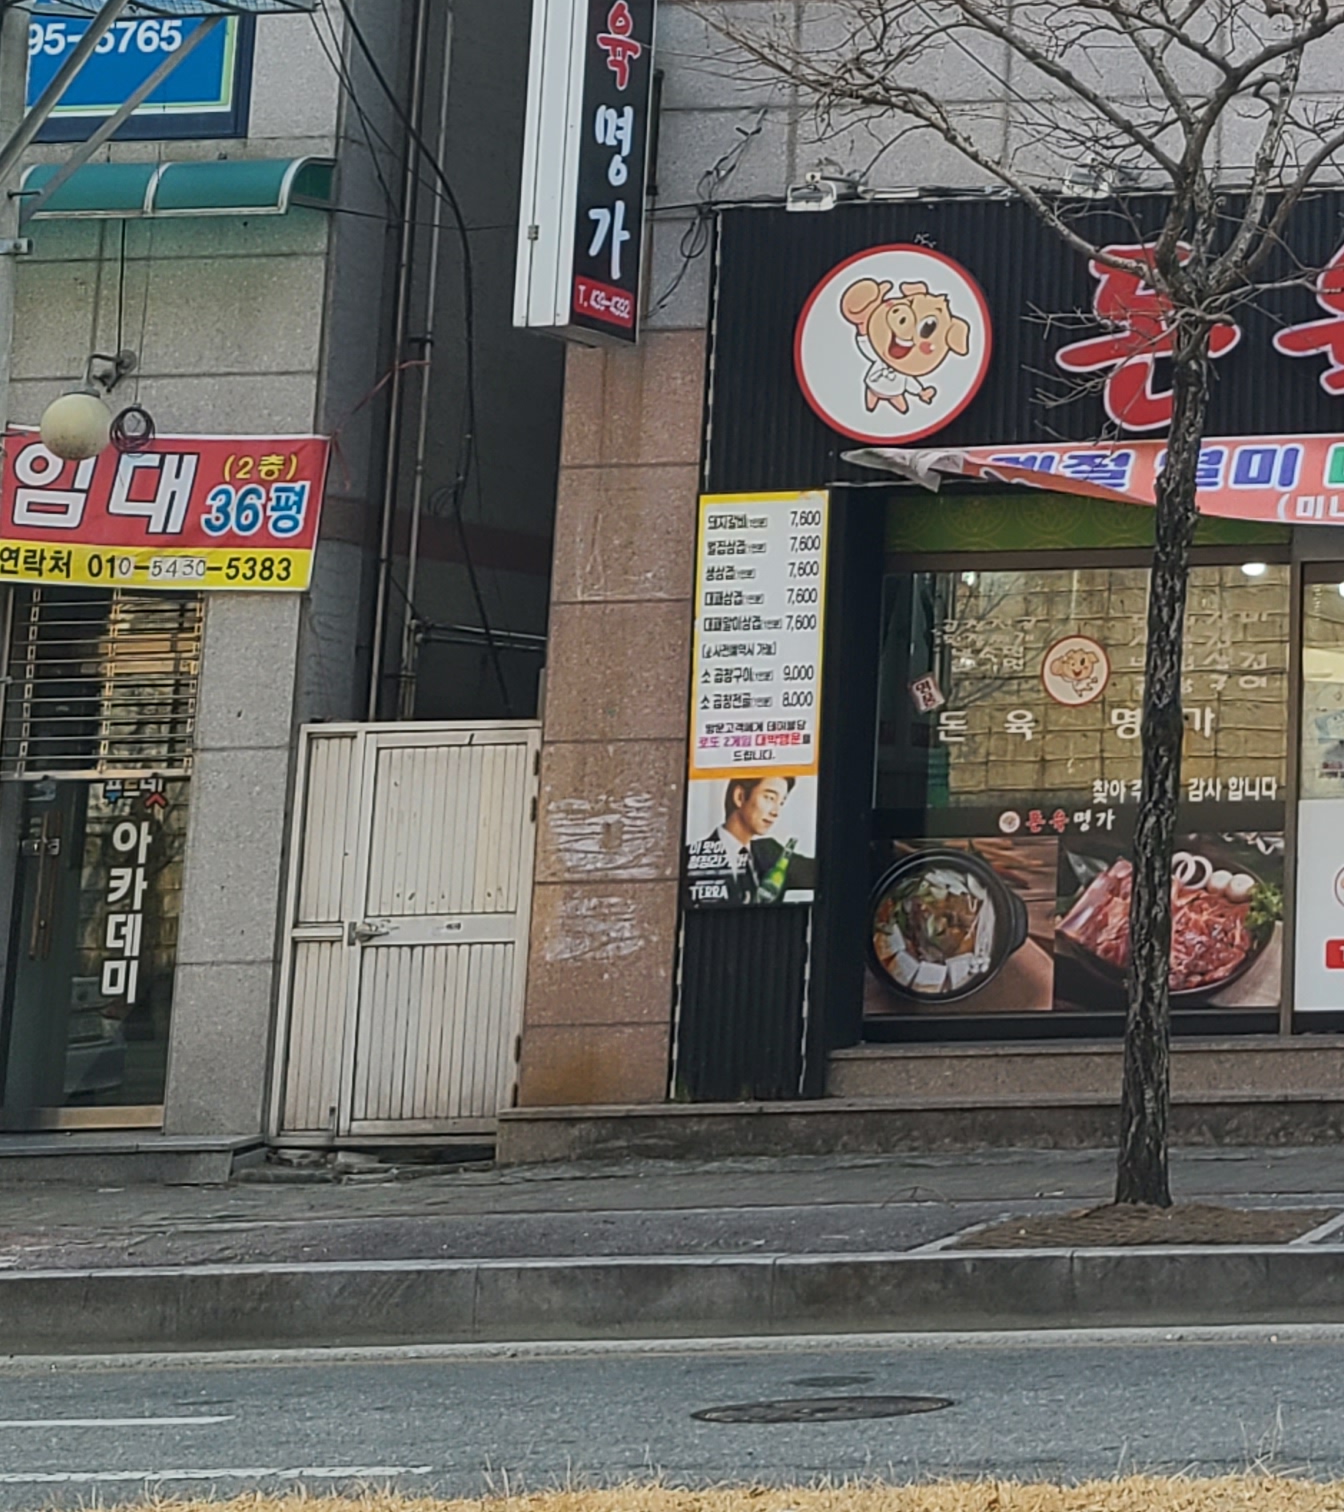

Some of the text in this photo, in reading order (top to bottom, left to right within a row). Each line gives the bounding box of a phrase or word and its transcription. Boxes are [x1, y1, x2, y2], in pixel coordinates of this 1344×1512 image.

[224, 454, 297, 481] (2층)
[12, 441, 310, 536] 임대 36평
[0, 548, 291, 581] 연락처 010-5430-5383
[1188, 778, 1221, 803] 감사
[1228, 776, 1278, 801] 합니다
[689, 886, 728, 901] TERRA
[101, 821, 152, 1004] 아카데미
